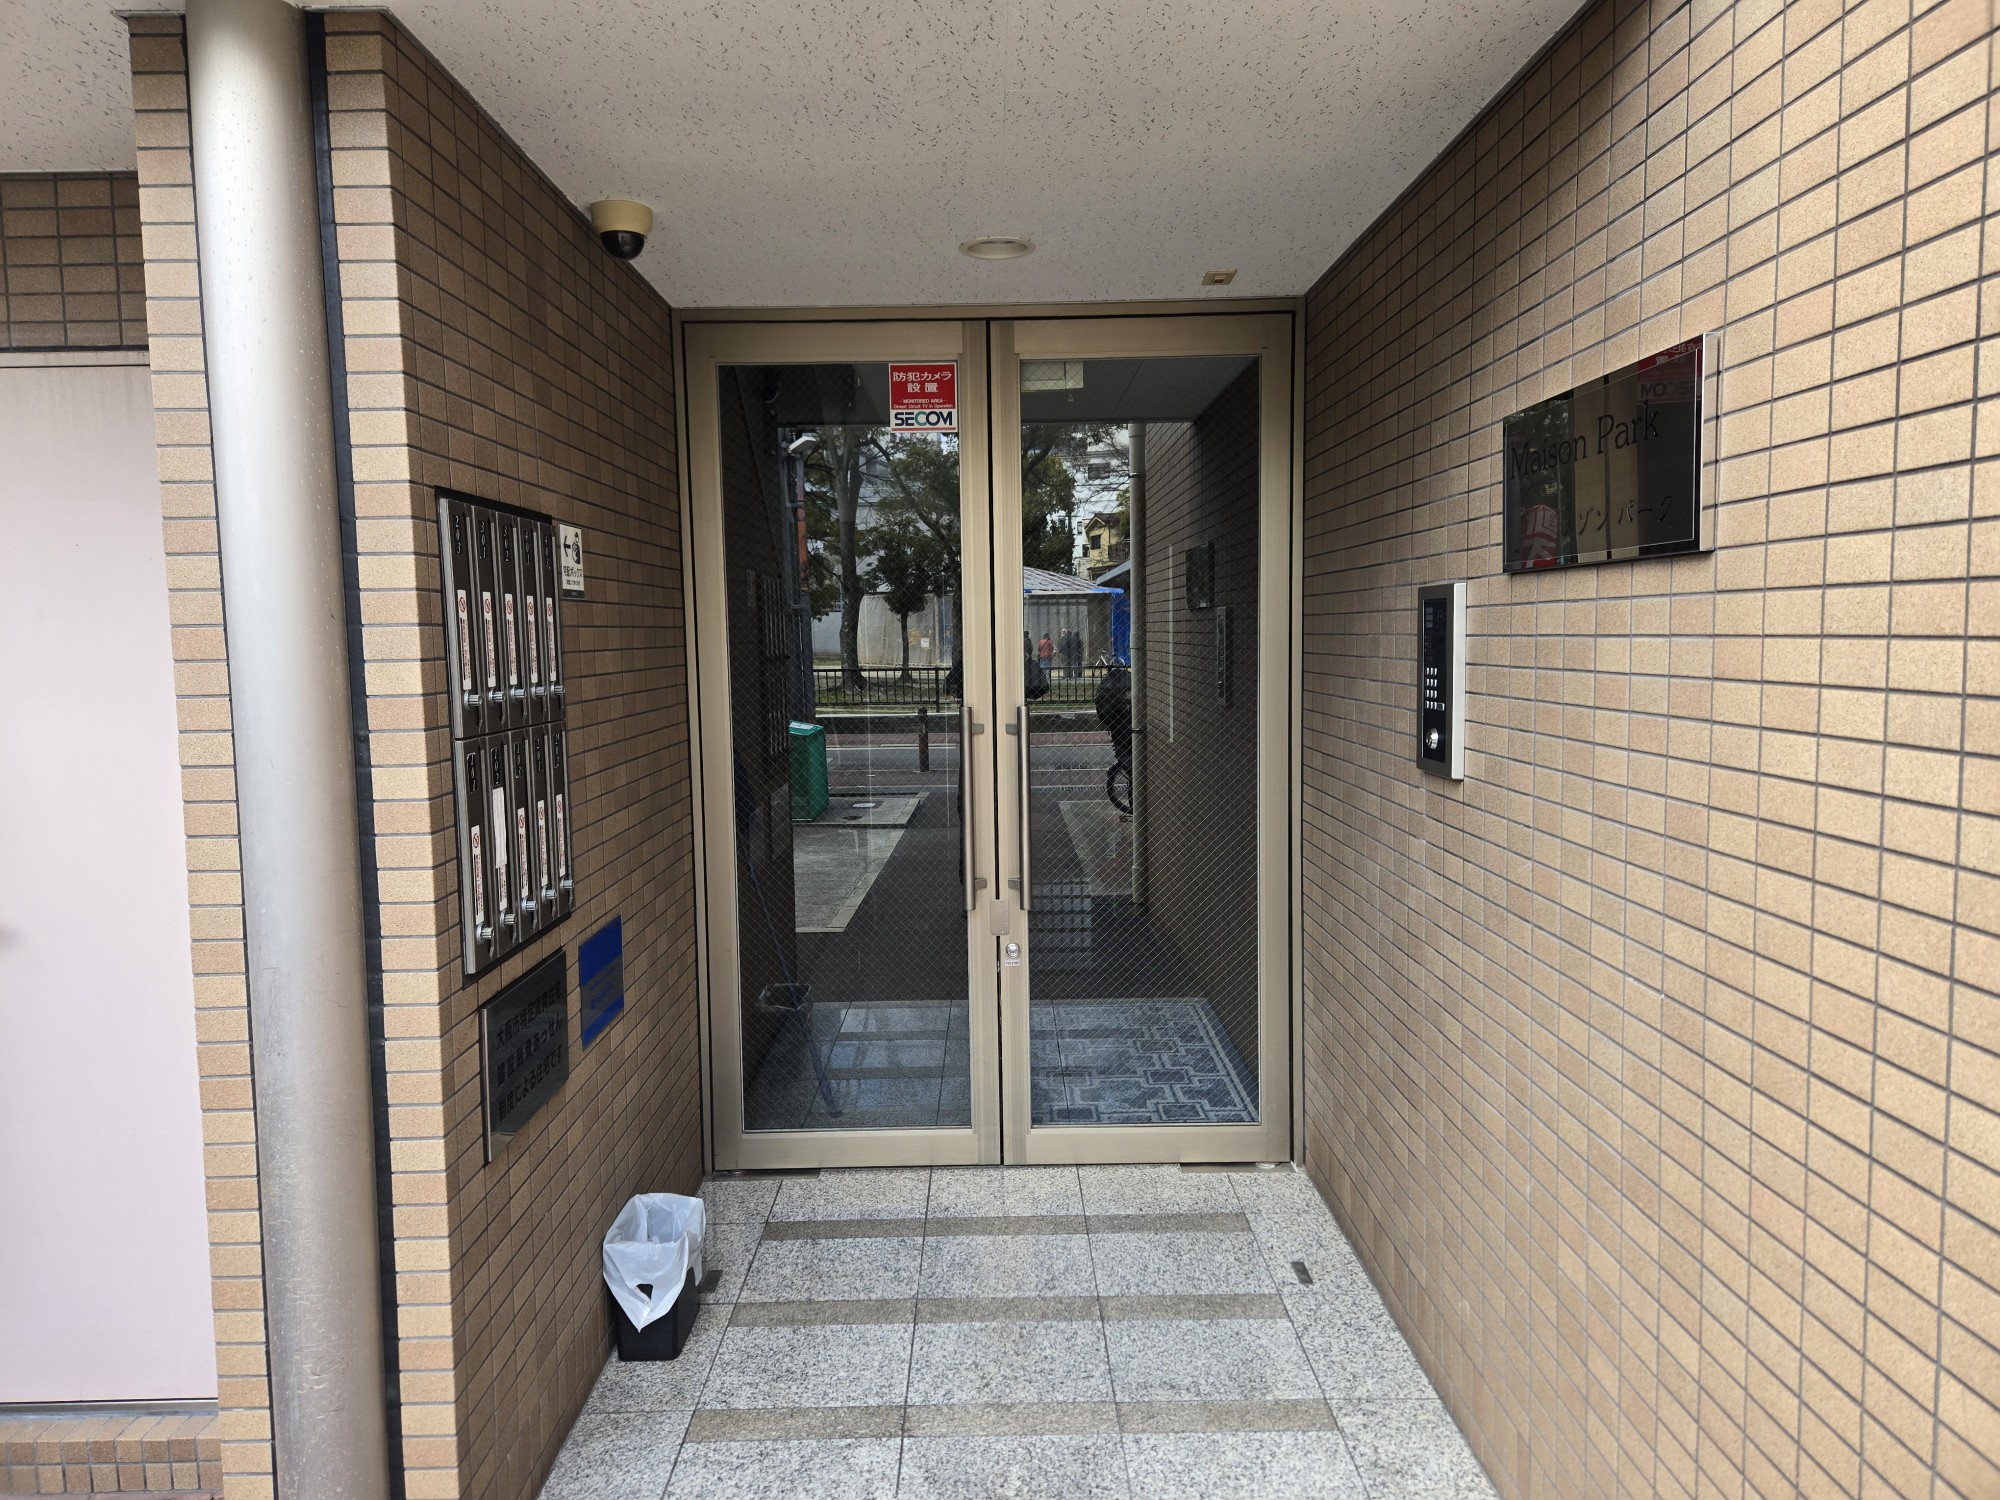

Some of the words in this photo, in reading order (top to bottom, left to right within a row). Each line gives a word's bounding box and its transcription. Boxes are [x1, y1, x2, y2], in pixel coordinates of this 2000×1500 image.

[893, 371, 952, 382] 防犯カメラ
[907, 382, 939, 393] 設置
[894, 410, 953, 427] SECOM
[1510, 435, 1588, 480] Maison
[1596, 399, 1659, 455] Park
[497, 1015, 562, 1087] 建設融資あっせん
[498, 1043, 563, 1122] 制度による住宅です
